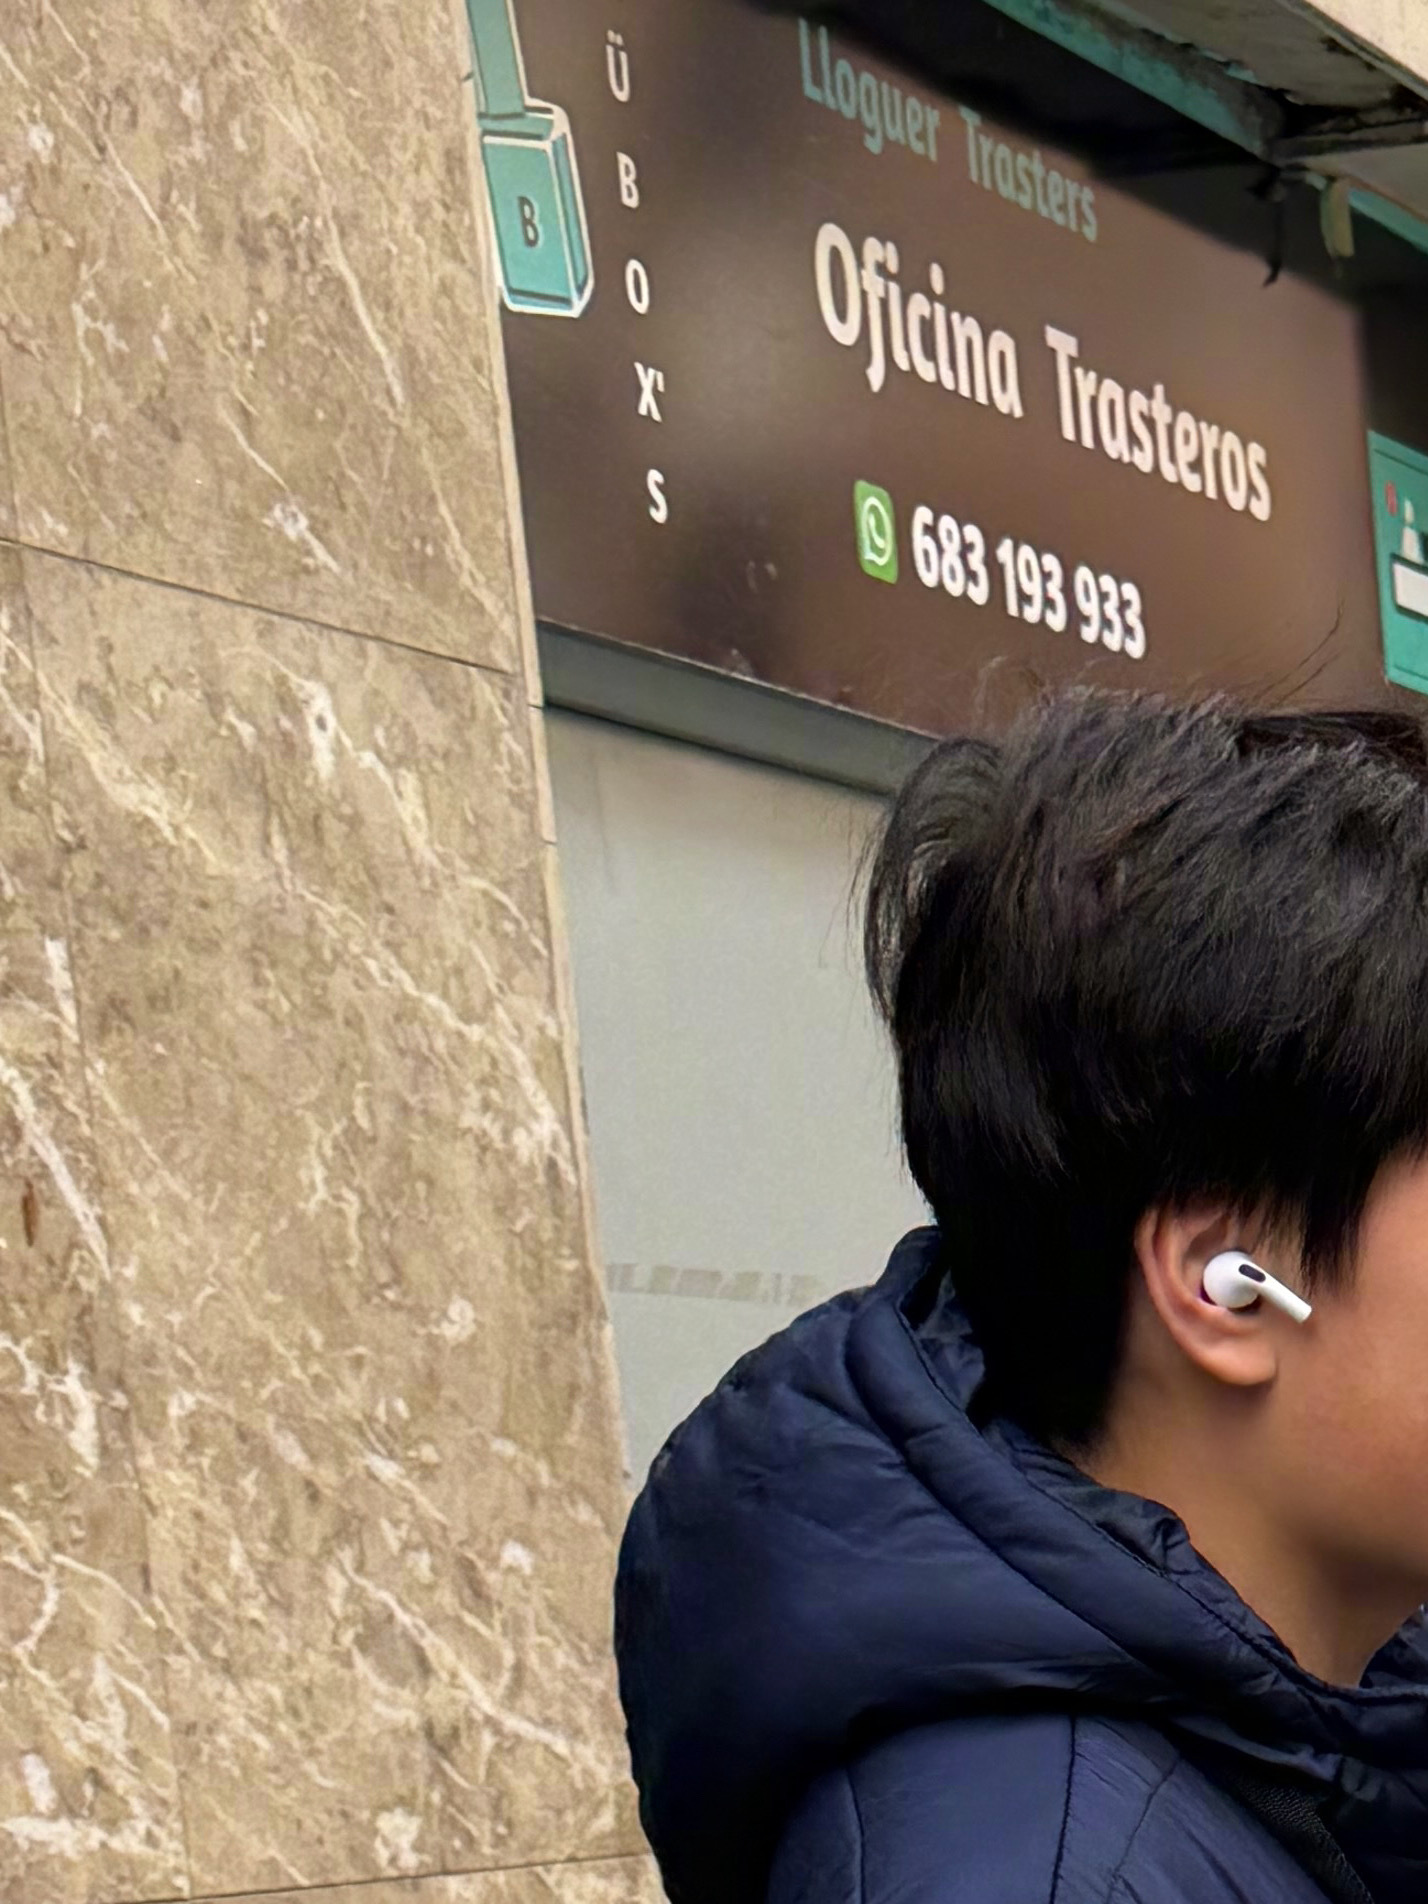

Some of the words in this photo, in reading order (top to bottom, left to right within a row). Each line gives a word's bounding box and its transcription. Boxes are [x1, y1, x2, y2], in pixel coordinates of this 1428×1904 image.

[517, 195, 540, 248] B
[798, 16, 940, 162] Lloguer
[958, 104, 1098, 243] Trasters
[814, 222, 1023, 392] Oficina
[1045, 324, 1271, 521] Trasteros
[911, 505, 989, 605] 683
[996, 538, 1067, 632] 193
[1074, 565, 1146, 659] 933
